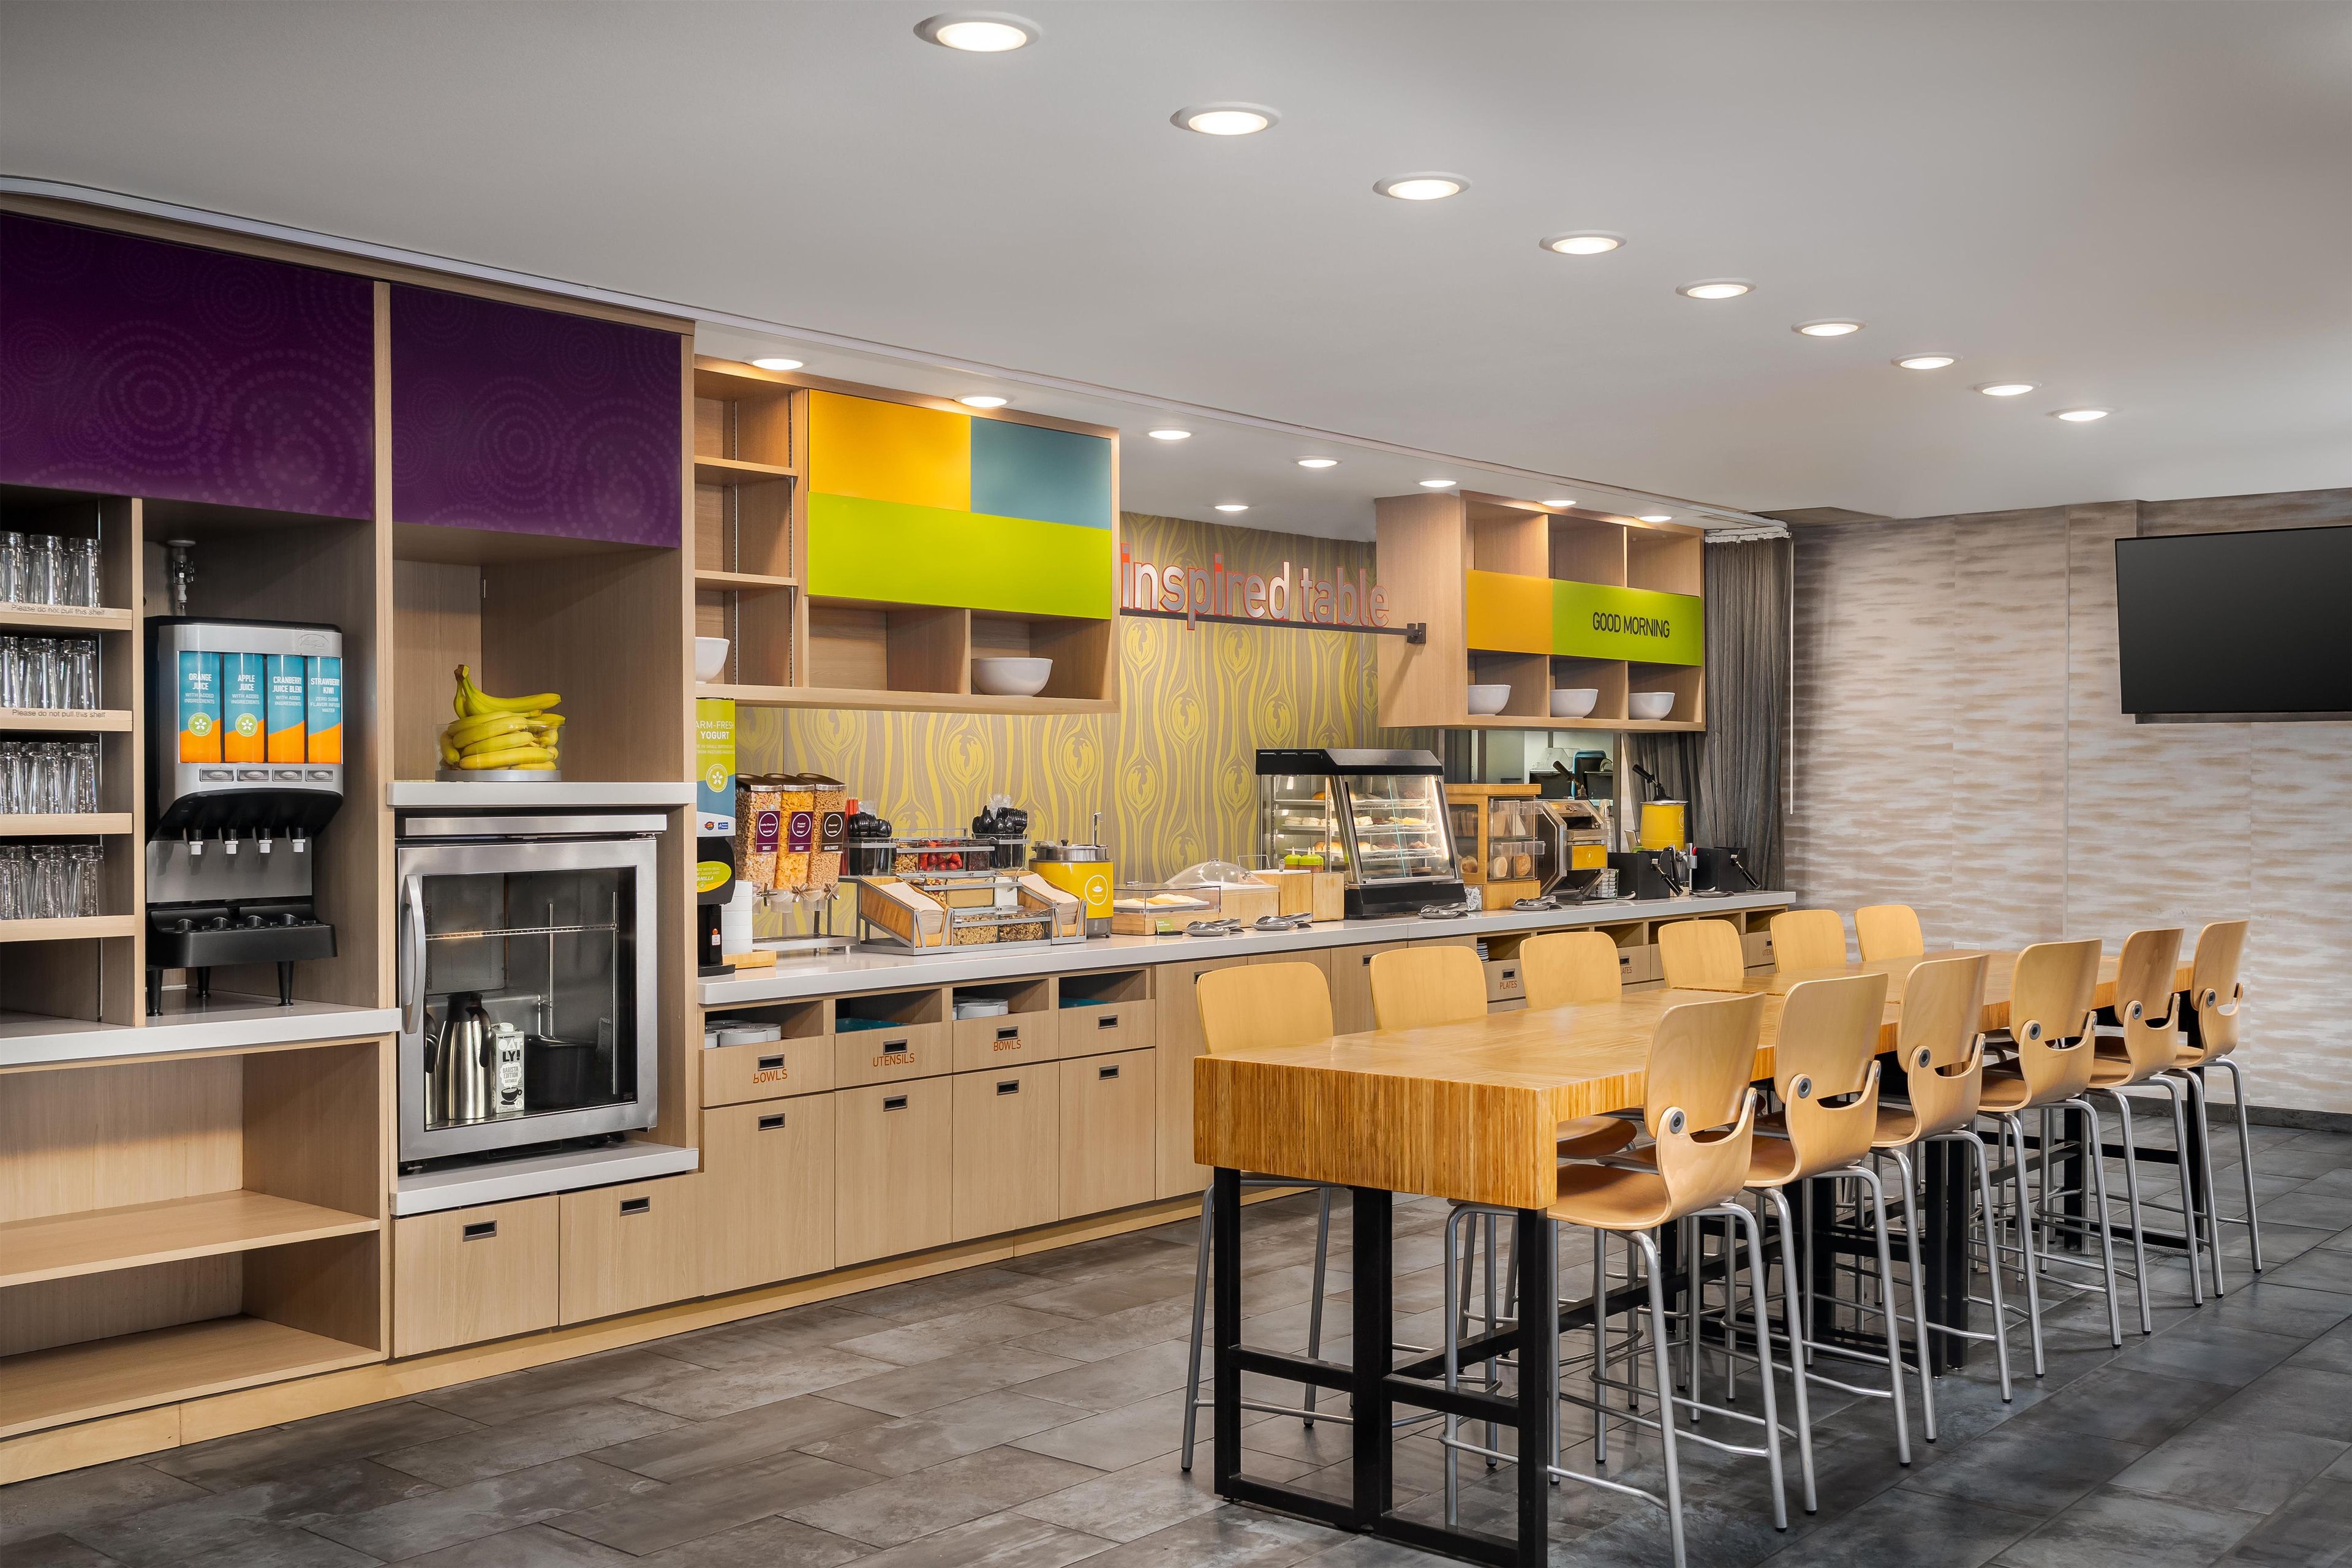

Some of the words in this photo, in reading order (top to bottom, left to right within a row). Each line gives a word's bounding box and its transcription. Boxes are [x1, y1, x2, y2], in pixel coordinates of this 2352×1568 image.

[1121, 543, 1290, 631] inspired
[1299, 567, 1390, 627] table
[1593, 612, 1621, 633] GOOD
[1624, 615, 1670, 638] MORNING
[696, 720, 734, 729] ARM-FRESH
[700, 731, 729, 739] YOGURT
[1621, 966, 1632, 974] ATES
[1499, 980, 1517, 990] PLATES
[993, 1040, 1022, 1052] BOWLS
[502, 1049, 521, 1062] LY!
[873, 1053, 915, 1067] UTENSILS
